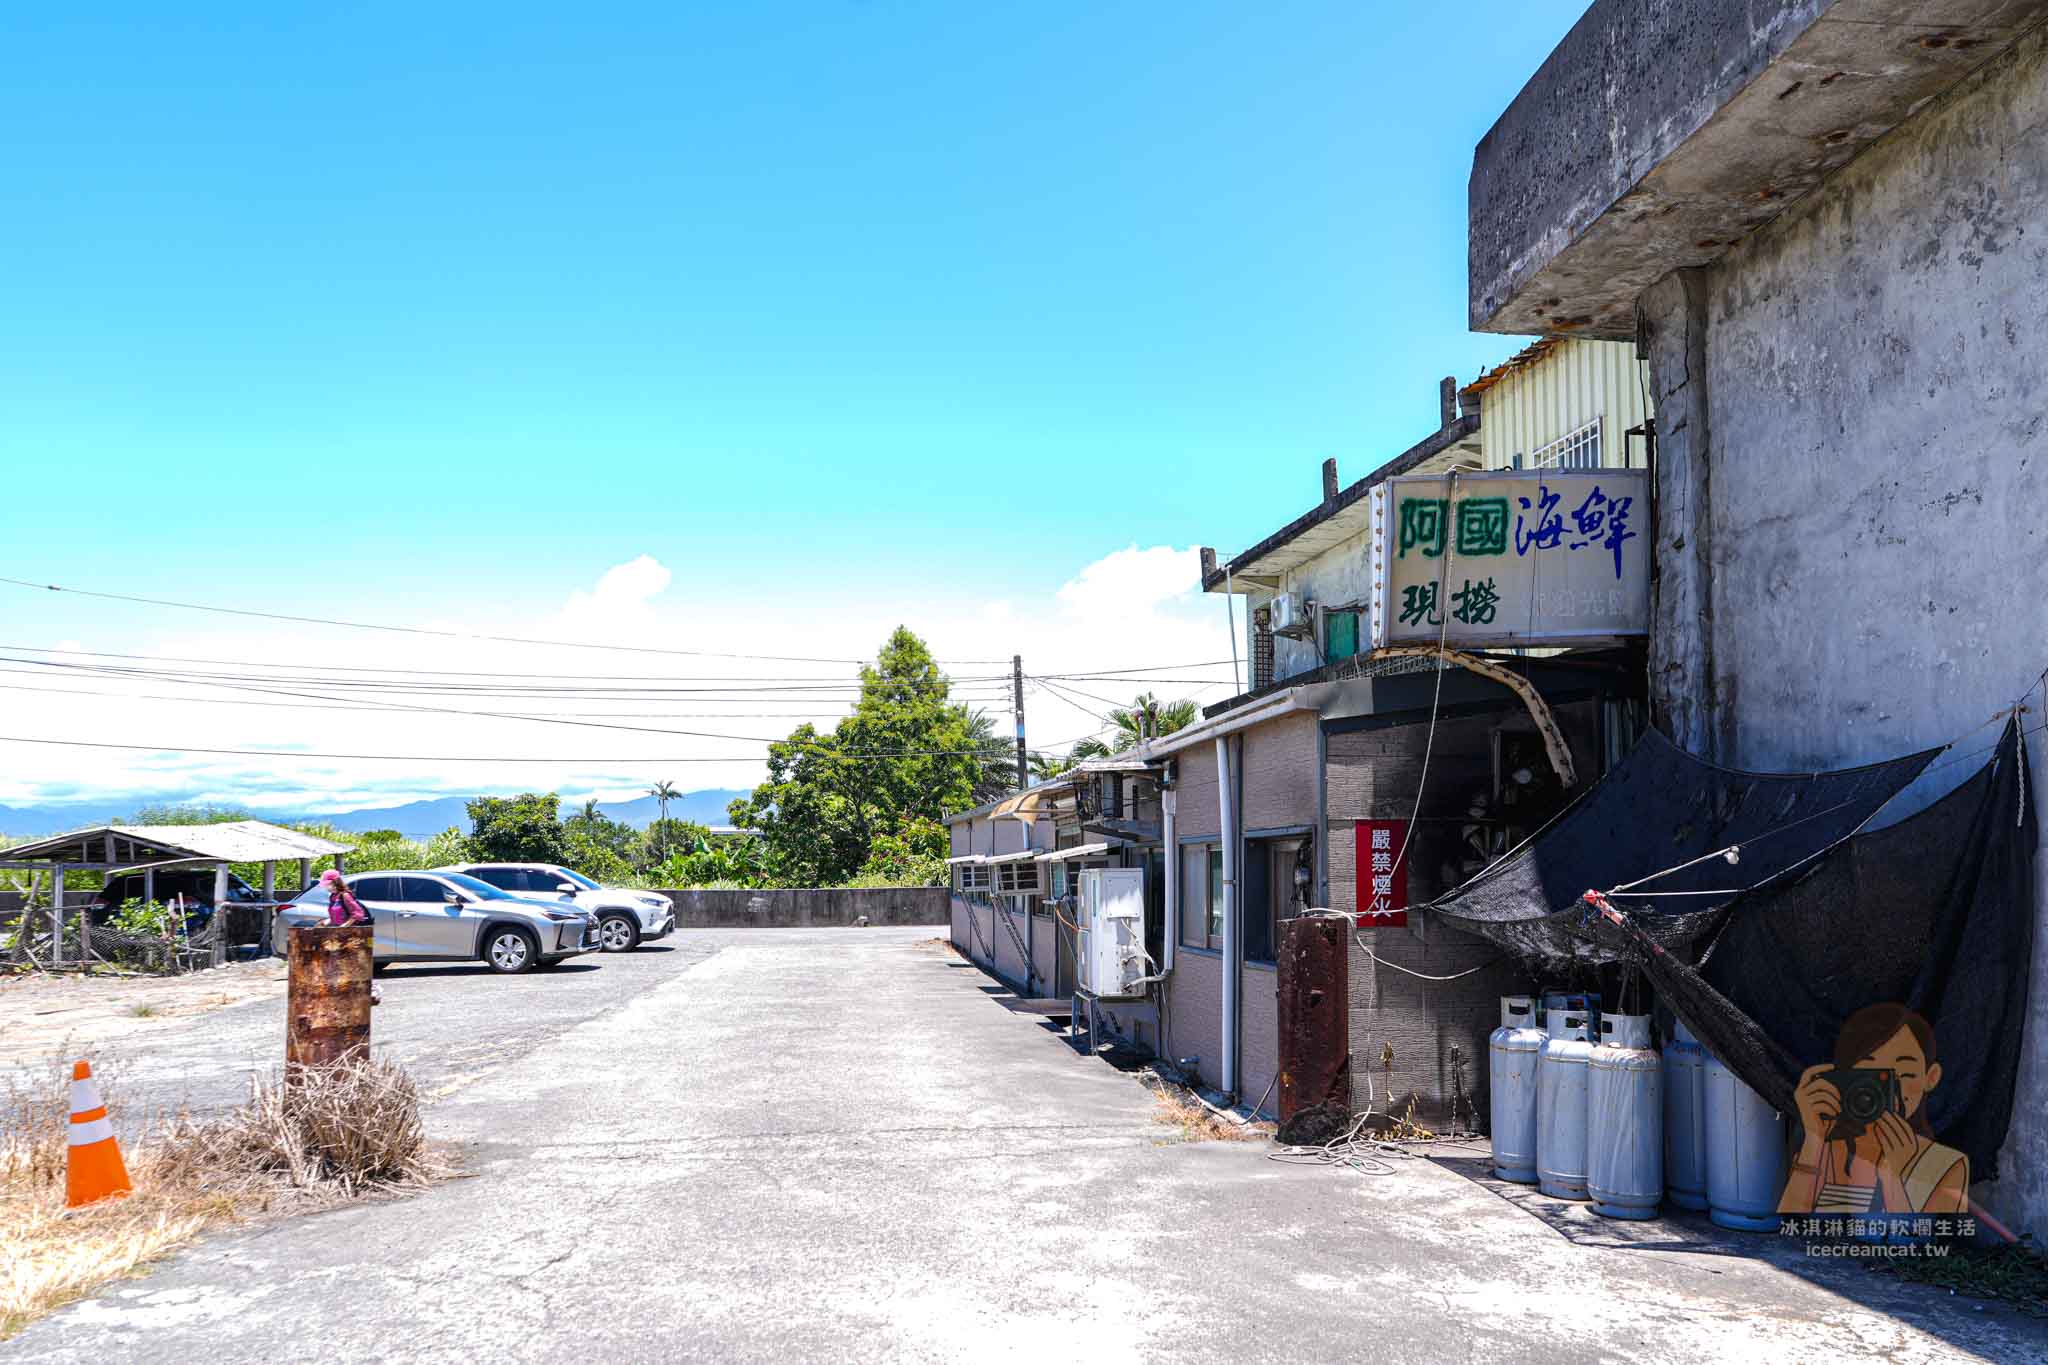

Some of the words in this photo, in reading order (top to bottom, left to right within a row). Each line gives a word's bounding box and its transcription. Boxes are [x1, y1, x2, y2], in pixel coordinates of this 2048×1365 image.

[1398, 485, 1636, 579] 阿國海鮮
[1399, 577, 1500, 626] 現撈
[1371, 829, 1392, 918] 嚴禁煙火
